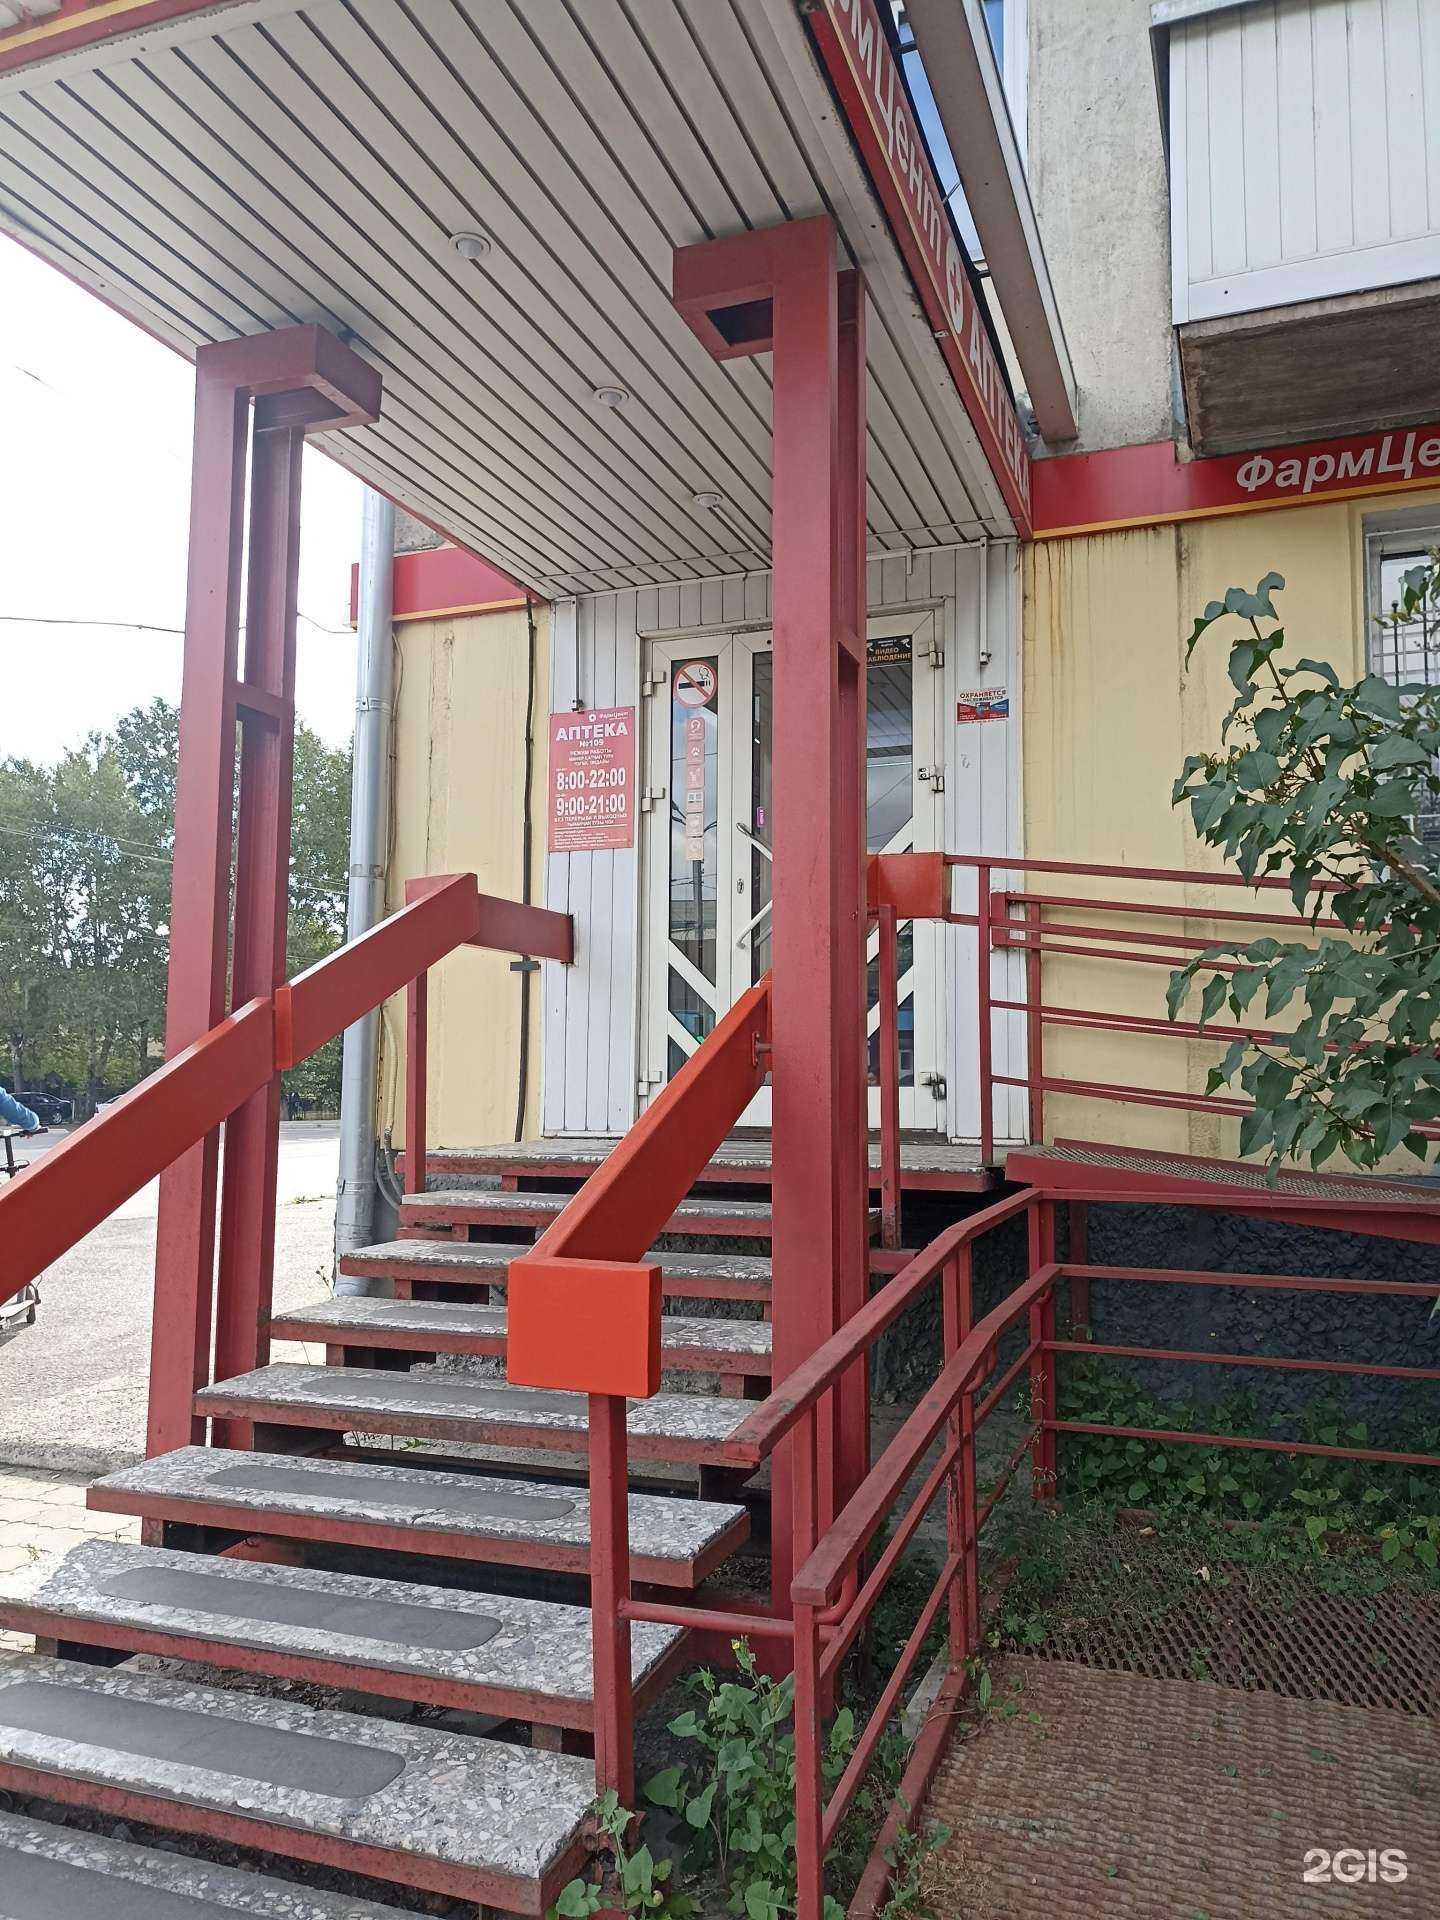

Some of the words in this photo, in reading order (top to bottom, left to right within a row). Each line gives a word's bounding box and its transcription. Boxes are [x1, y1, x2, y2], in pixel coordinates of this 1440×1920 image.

[831, 0, 942, 264] мЦент
[969, 307, 1031, 518] АПТЕКА
[1236, 432, 1440, 494] ФармЦе
[867, 652, 912, 663] АБЛЮДЕНИЕ
[875, 647, 899, 655] ВИДЕО
[959, 689, 1007, 699] ОХРАНЯЕТСЯ
[555, 721, 628, 741] АПТЕКА
[579, 738, 604, 748] №109
[556, 767, 626, 791] 8:00-22:00
[556, 793, 626, 816] 9:00-21:00
